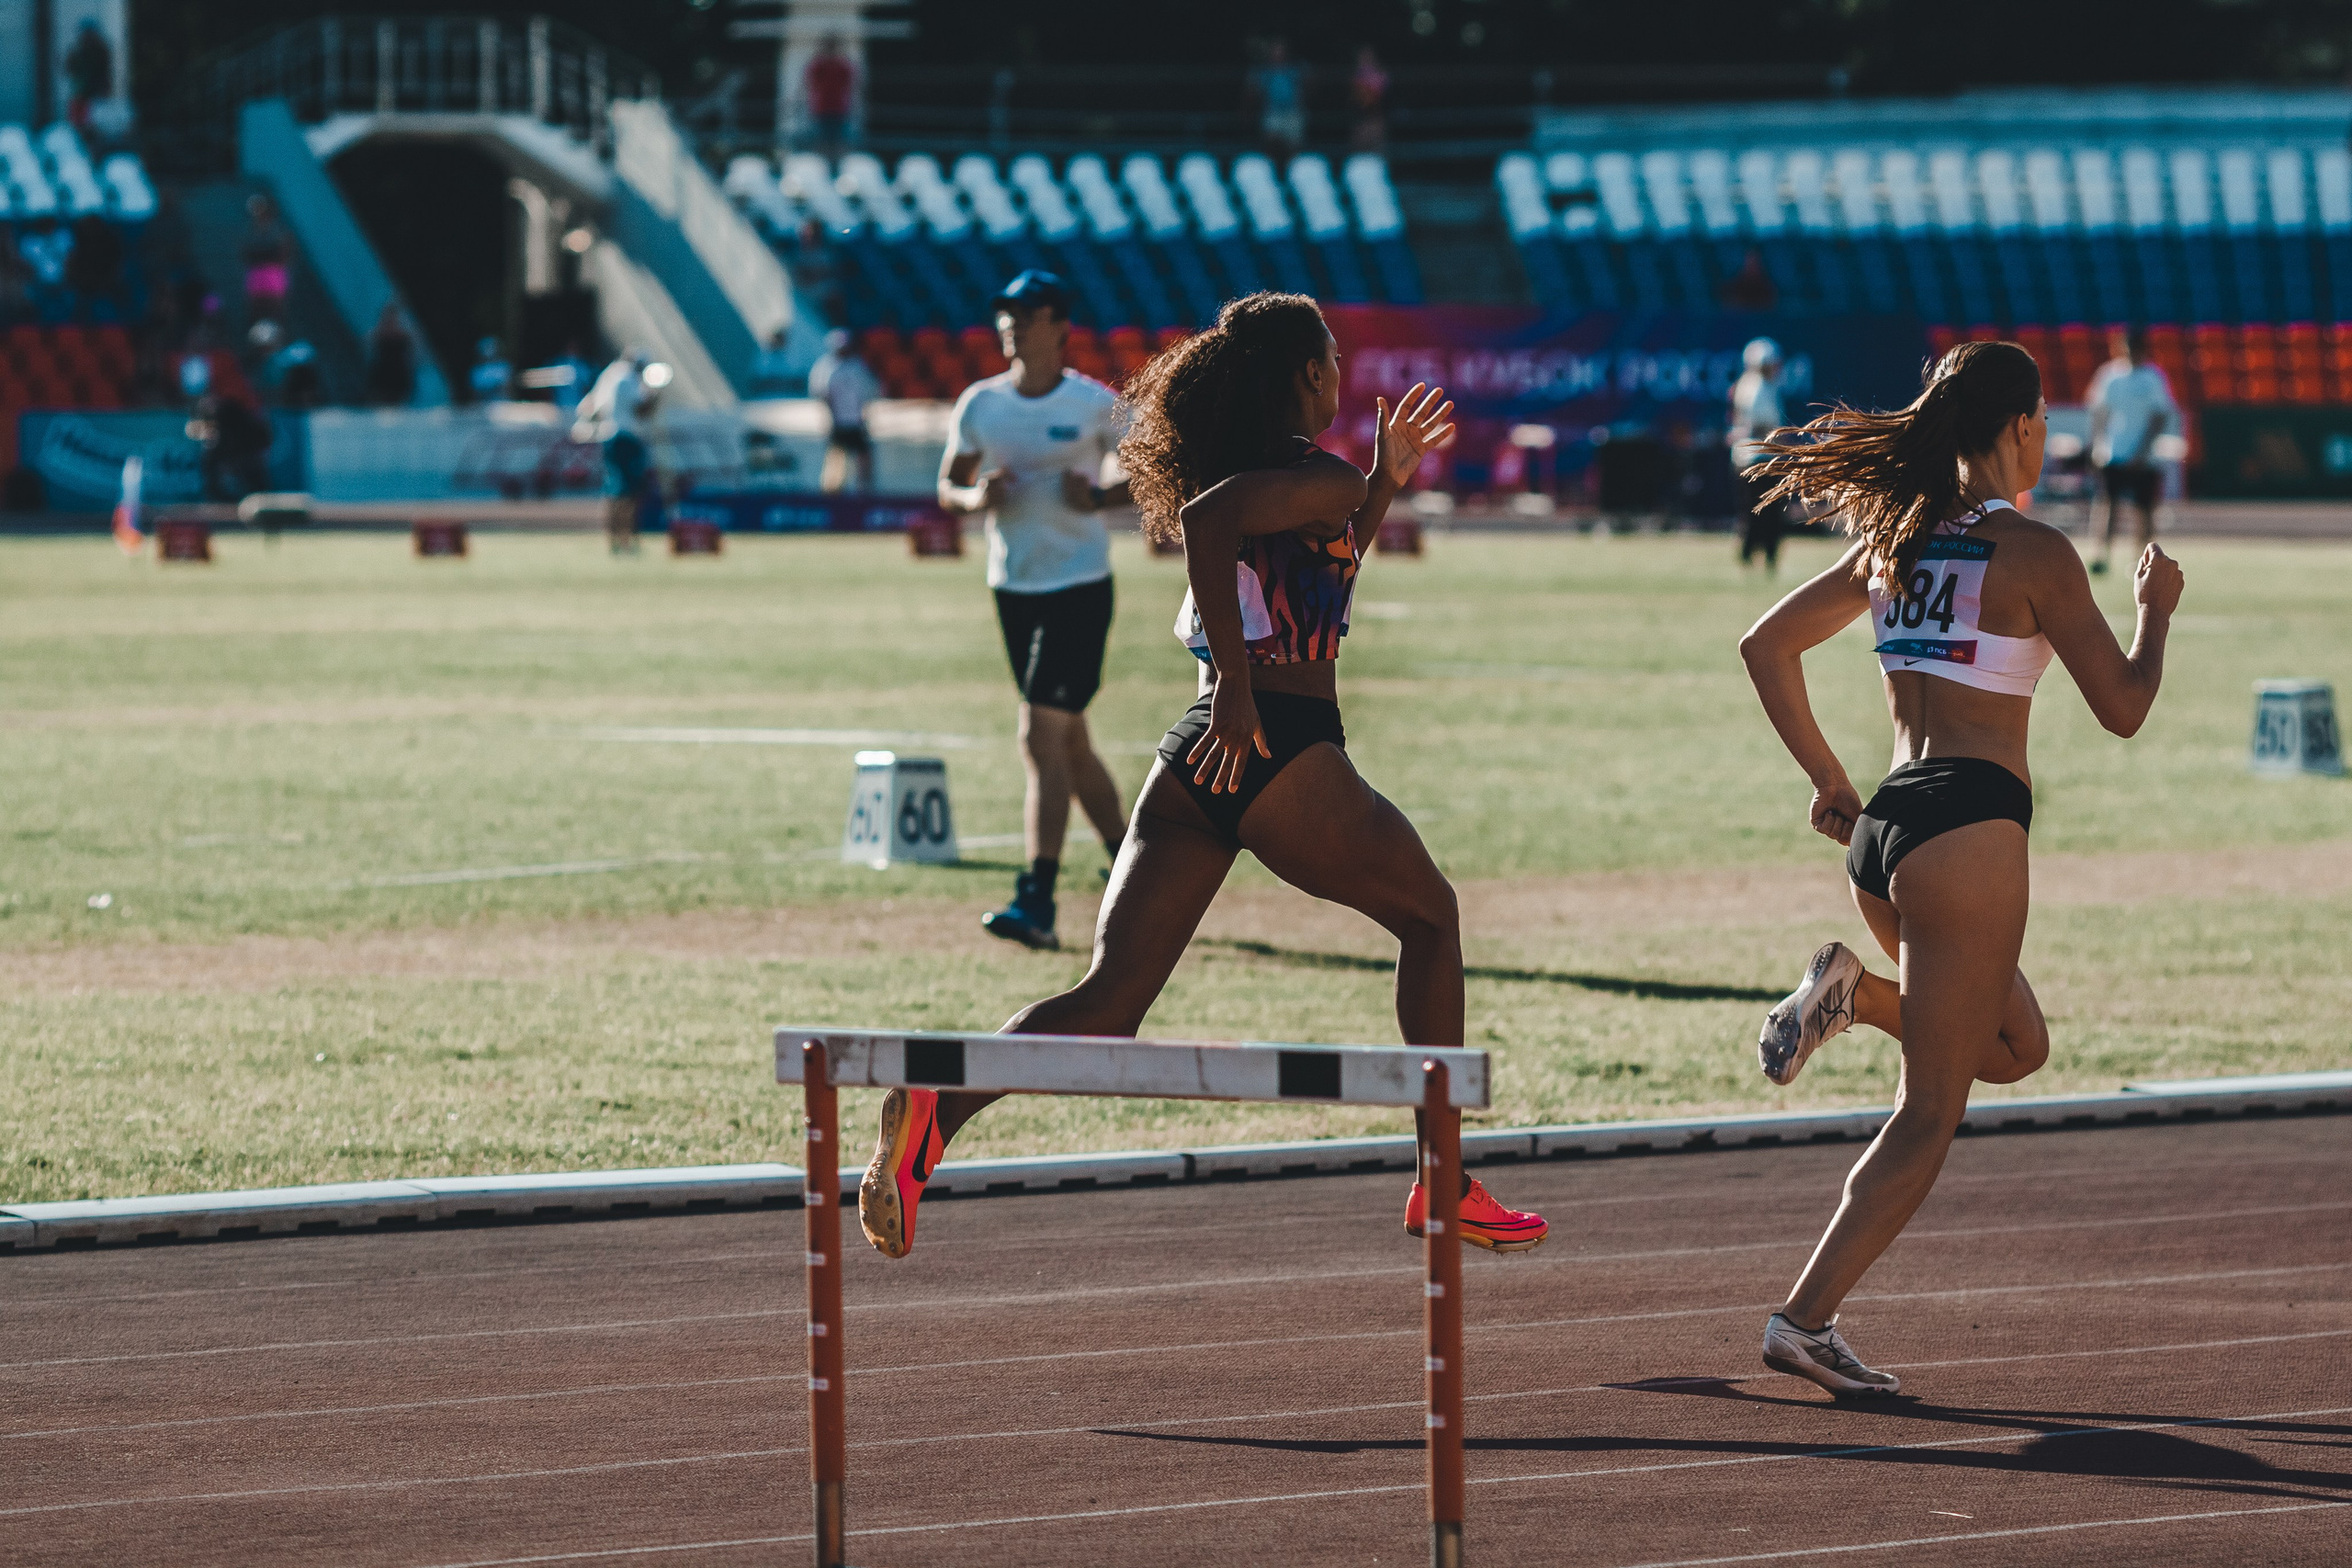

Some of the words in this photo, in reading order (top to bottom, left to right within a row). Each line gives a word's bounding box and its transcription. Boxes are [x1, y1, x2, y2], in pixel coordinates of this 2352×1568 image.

[1943, 542, 1985, 555] РОССИИ
[1935, 647, 1947, 655] ПСБ
[898, 788, 950, 845] 60
